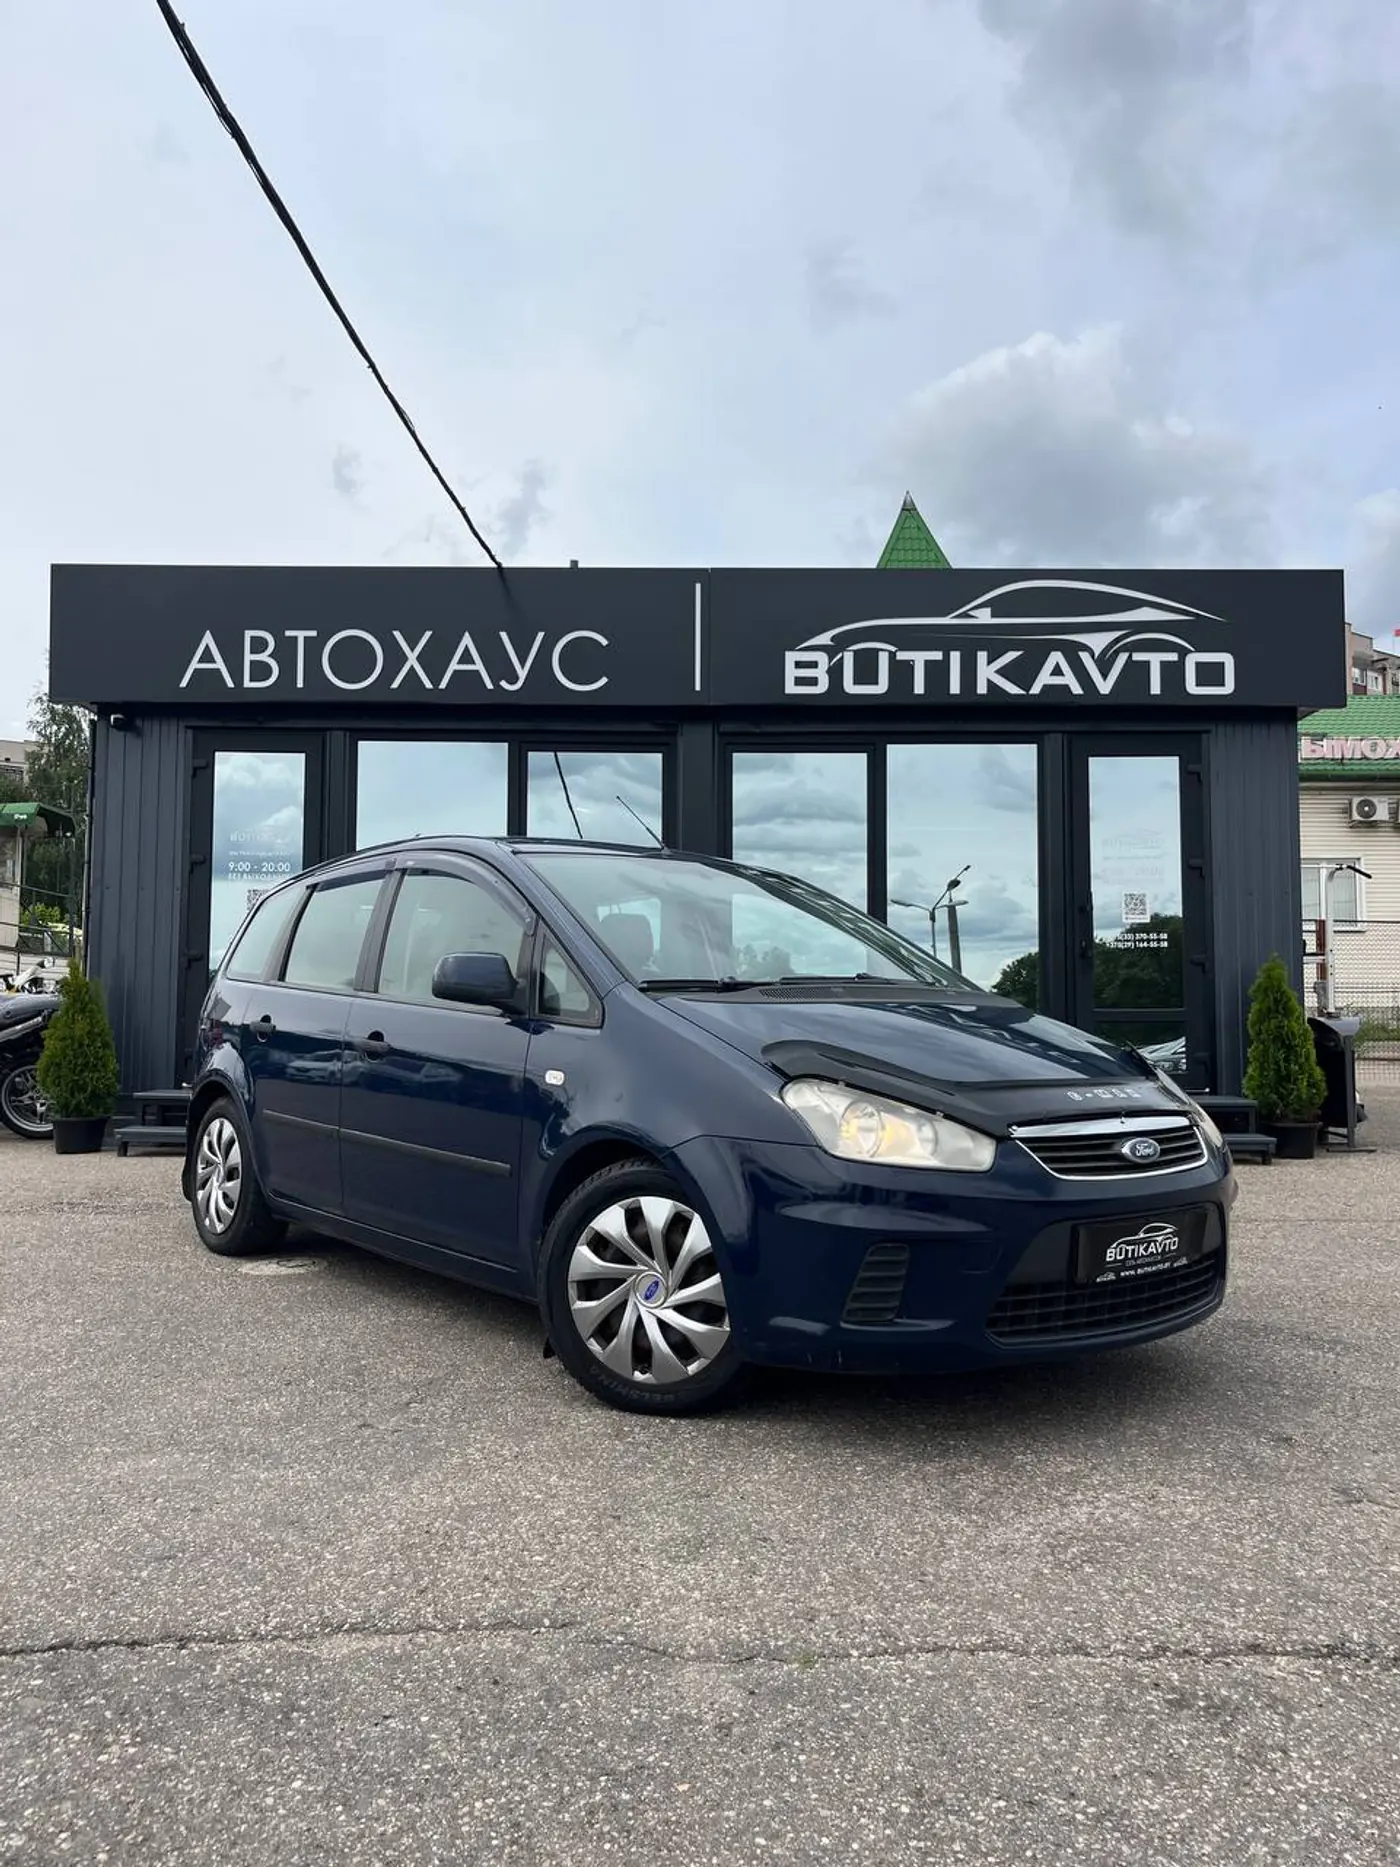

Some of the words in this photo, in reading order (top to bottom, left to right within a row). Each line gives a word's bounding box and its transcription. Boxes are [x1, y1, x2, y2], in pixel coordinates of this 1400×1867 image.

[180, 629, 609, 692] АВТОХАУС
[784, 650, 1235, 695] BUTIKAVTO
[228, 861, 251, 872] 9:00
[1105, 1236, 1180, 1262] BUTIKAVTO
